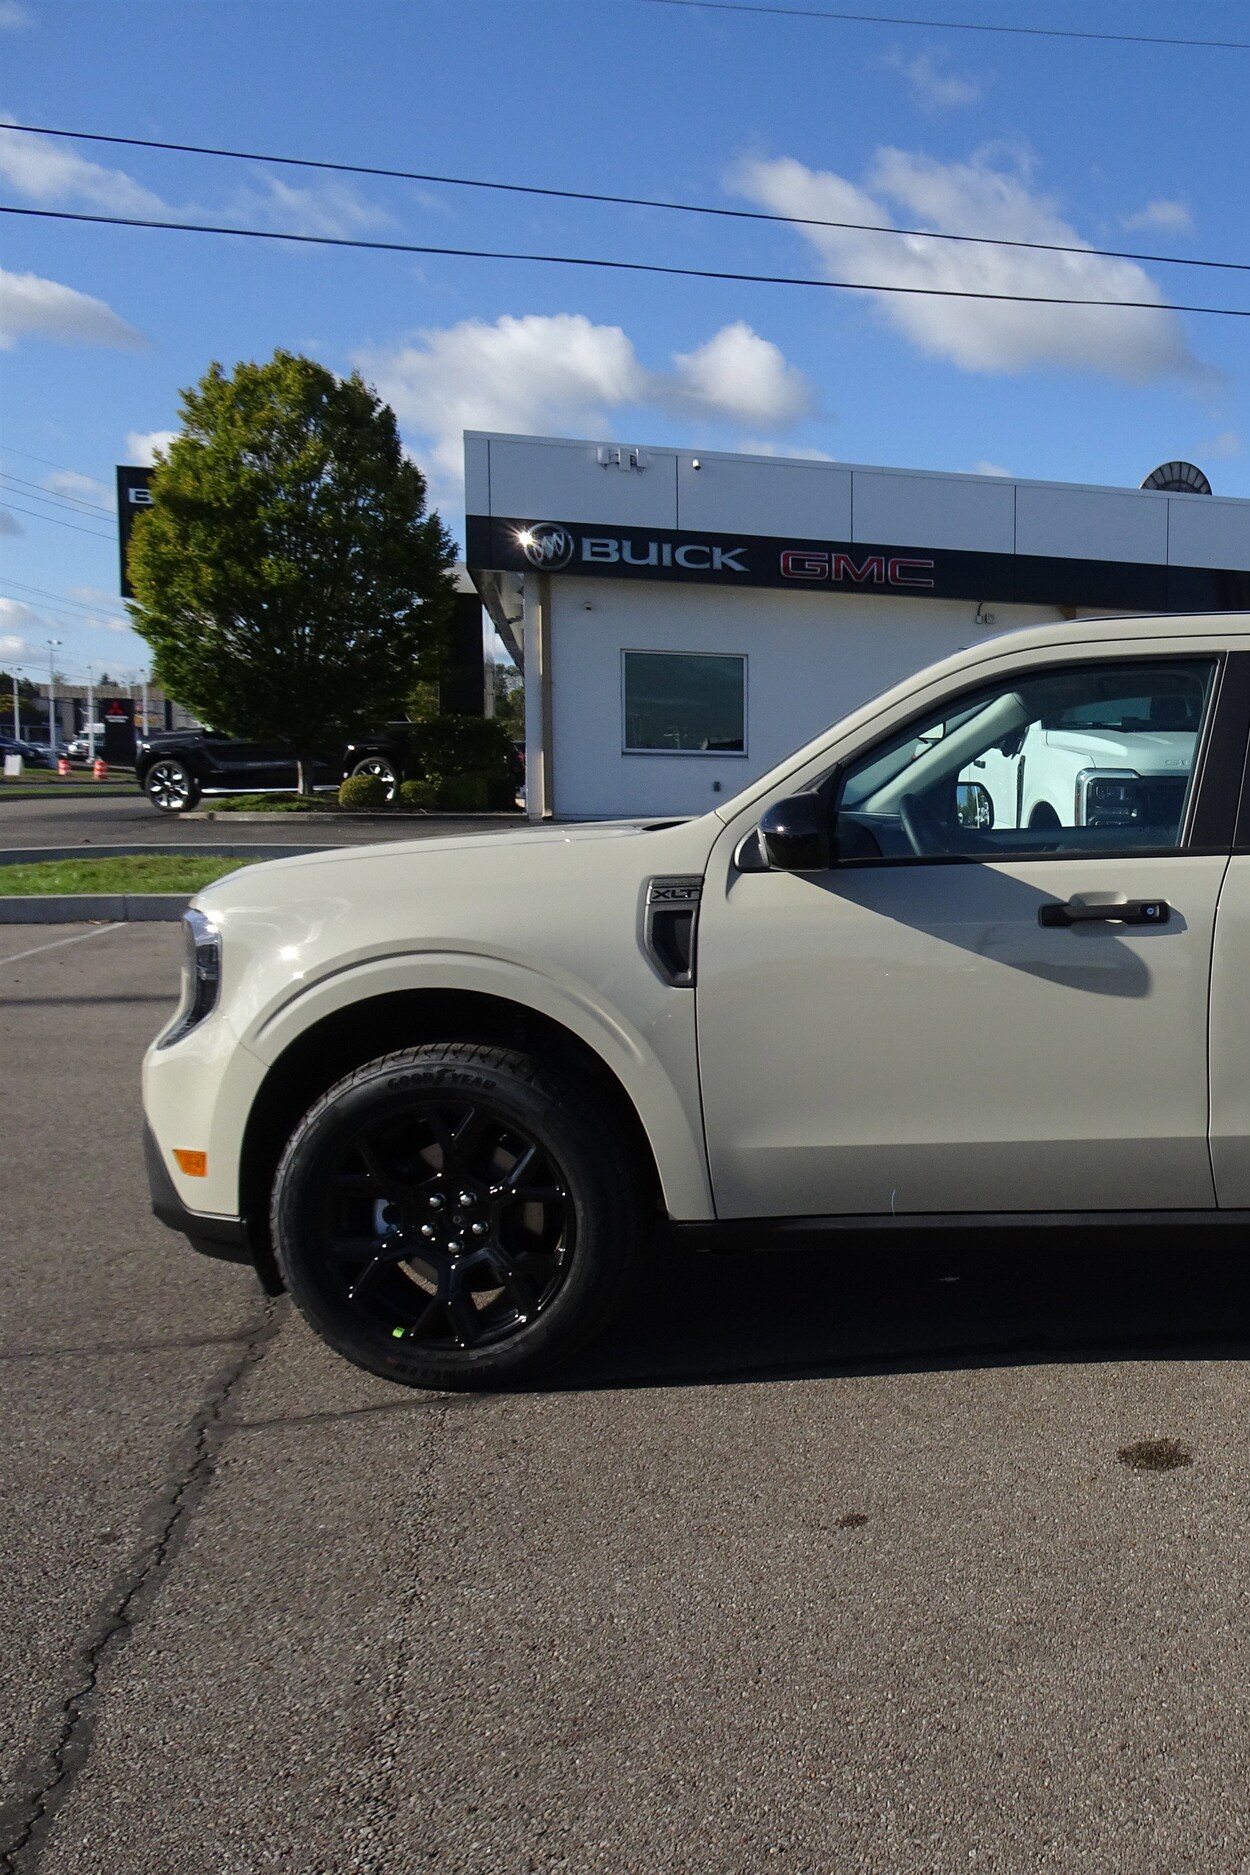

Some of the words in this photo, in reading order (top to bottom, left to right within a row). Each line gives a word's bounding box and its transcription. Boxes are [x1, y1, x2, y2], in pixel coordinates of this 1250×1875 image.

[581, 537, 750, 572] BUICK
[780, 550, 935, 588] GMC
[652, 888, 700, 900] XLT
